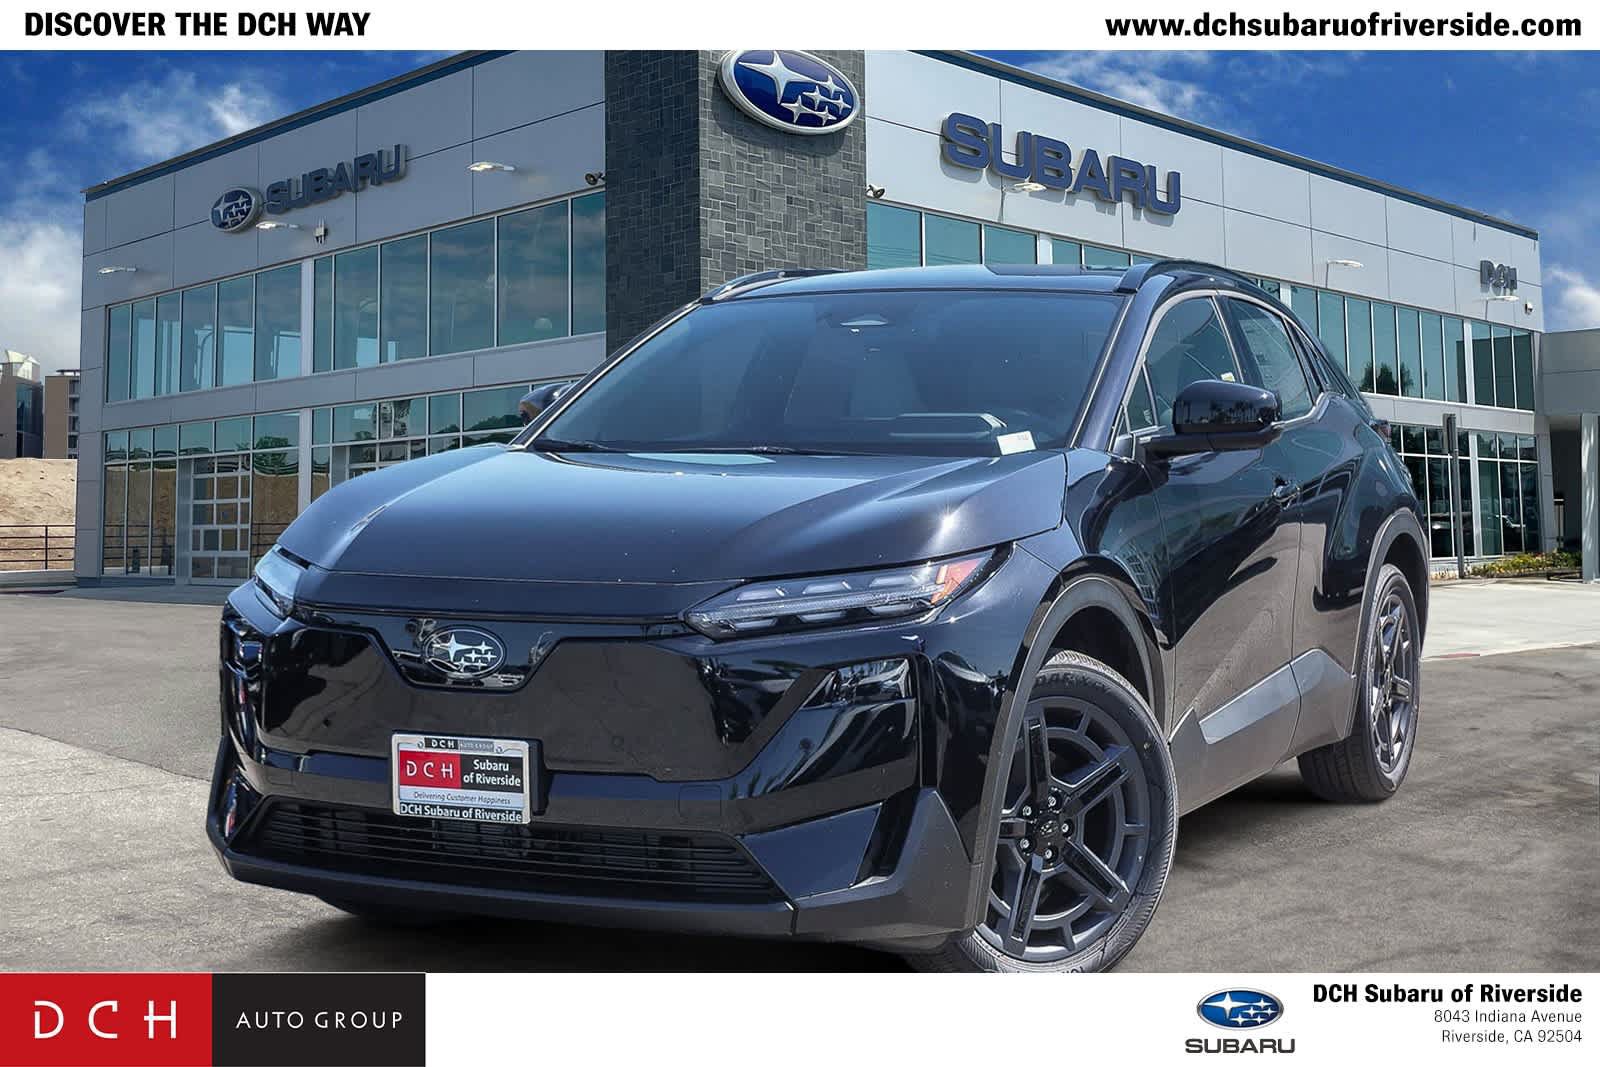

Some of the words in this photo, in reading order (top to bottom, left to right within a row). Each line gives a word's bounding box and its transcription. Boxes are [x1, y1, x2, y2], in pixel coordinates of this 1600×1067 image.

[941, 112, 1181, 215] SUBARU
[265, 144, 407, 215] SUBARU
[431, 739, 455, 749] DCH
[406, 760, 453, 779] DCH
[473, 759, 509, 772] Subaru
[463, 772, 474, 784] of
[475, 773, 521, 787] Riverside
[413, 791, 446, 801] Delivering
[447, 793, 477, 802] Customer
[478, 795, 511, 806] Happiness
[400, 803, 423, 814] DCH
[424, 805, 460, 817] Subaru
[462, 808, 474, 818] of
[474, 808, 522, 822] Riverside
